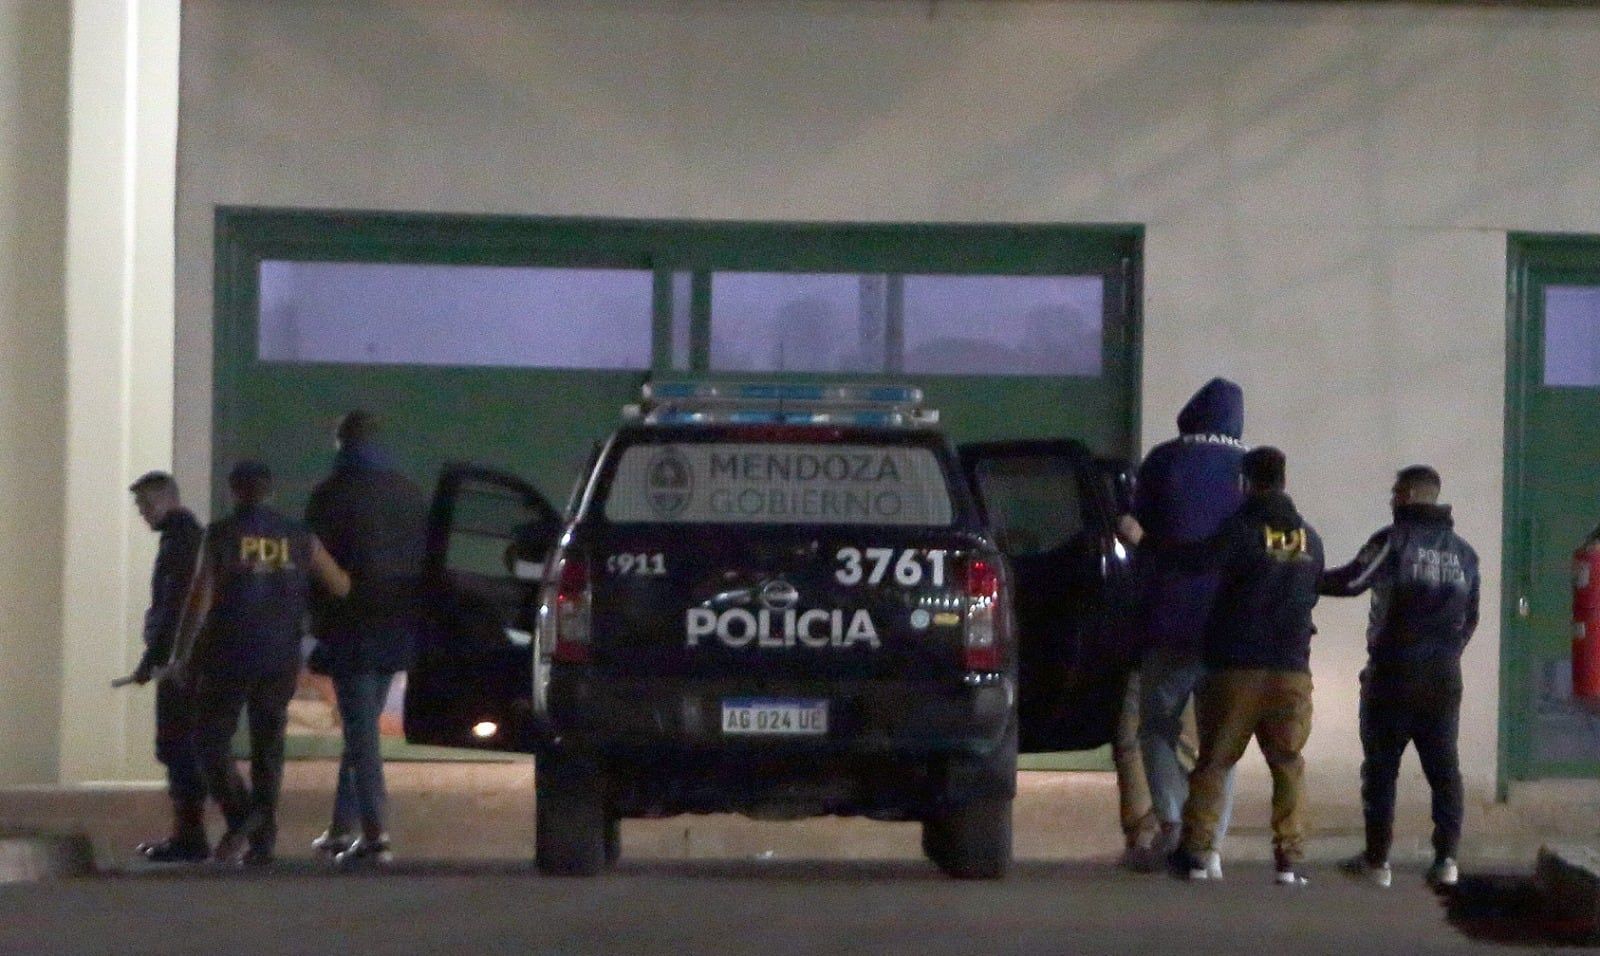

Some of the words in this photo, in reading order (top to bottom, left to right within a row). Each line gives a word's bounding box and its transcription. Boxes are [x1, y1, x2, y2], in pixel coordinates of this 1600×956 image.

[709, 453, 900, 481] MENDOZA
[708, 488, 901, 515] GOBIERNO
[240, 536, 289, 562] PDI
[617, 552, 667, 575] 911
[835, 548, 946, 586] 3761
[686, 608, 881, 650] POLICIA
[727, 709, 751, 729] AG
[756, 709, 791, 730] 024
[798, 709, 823, 730] UE
